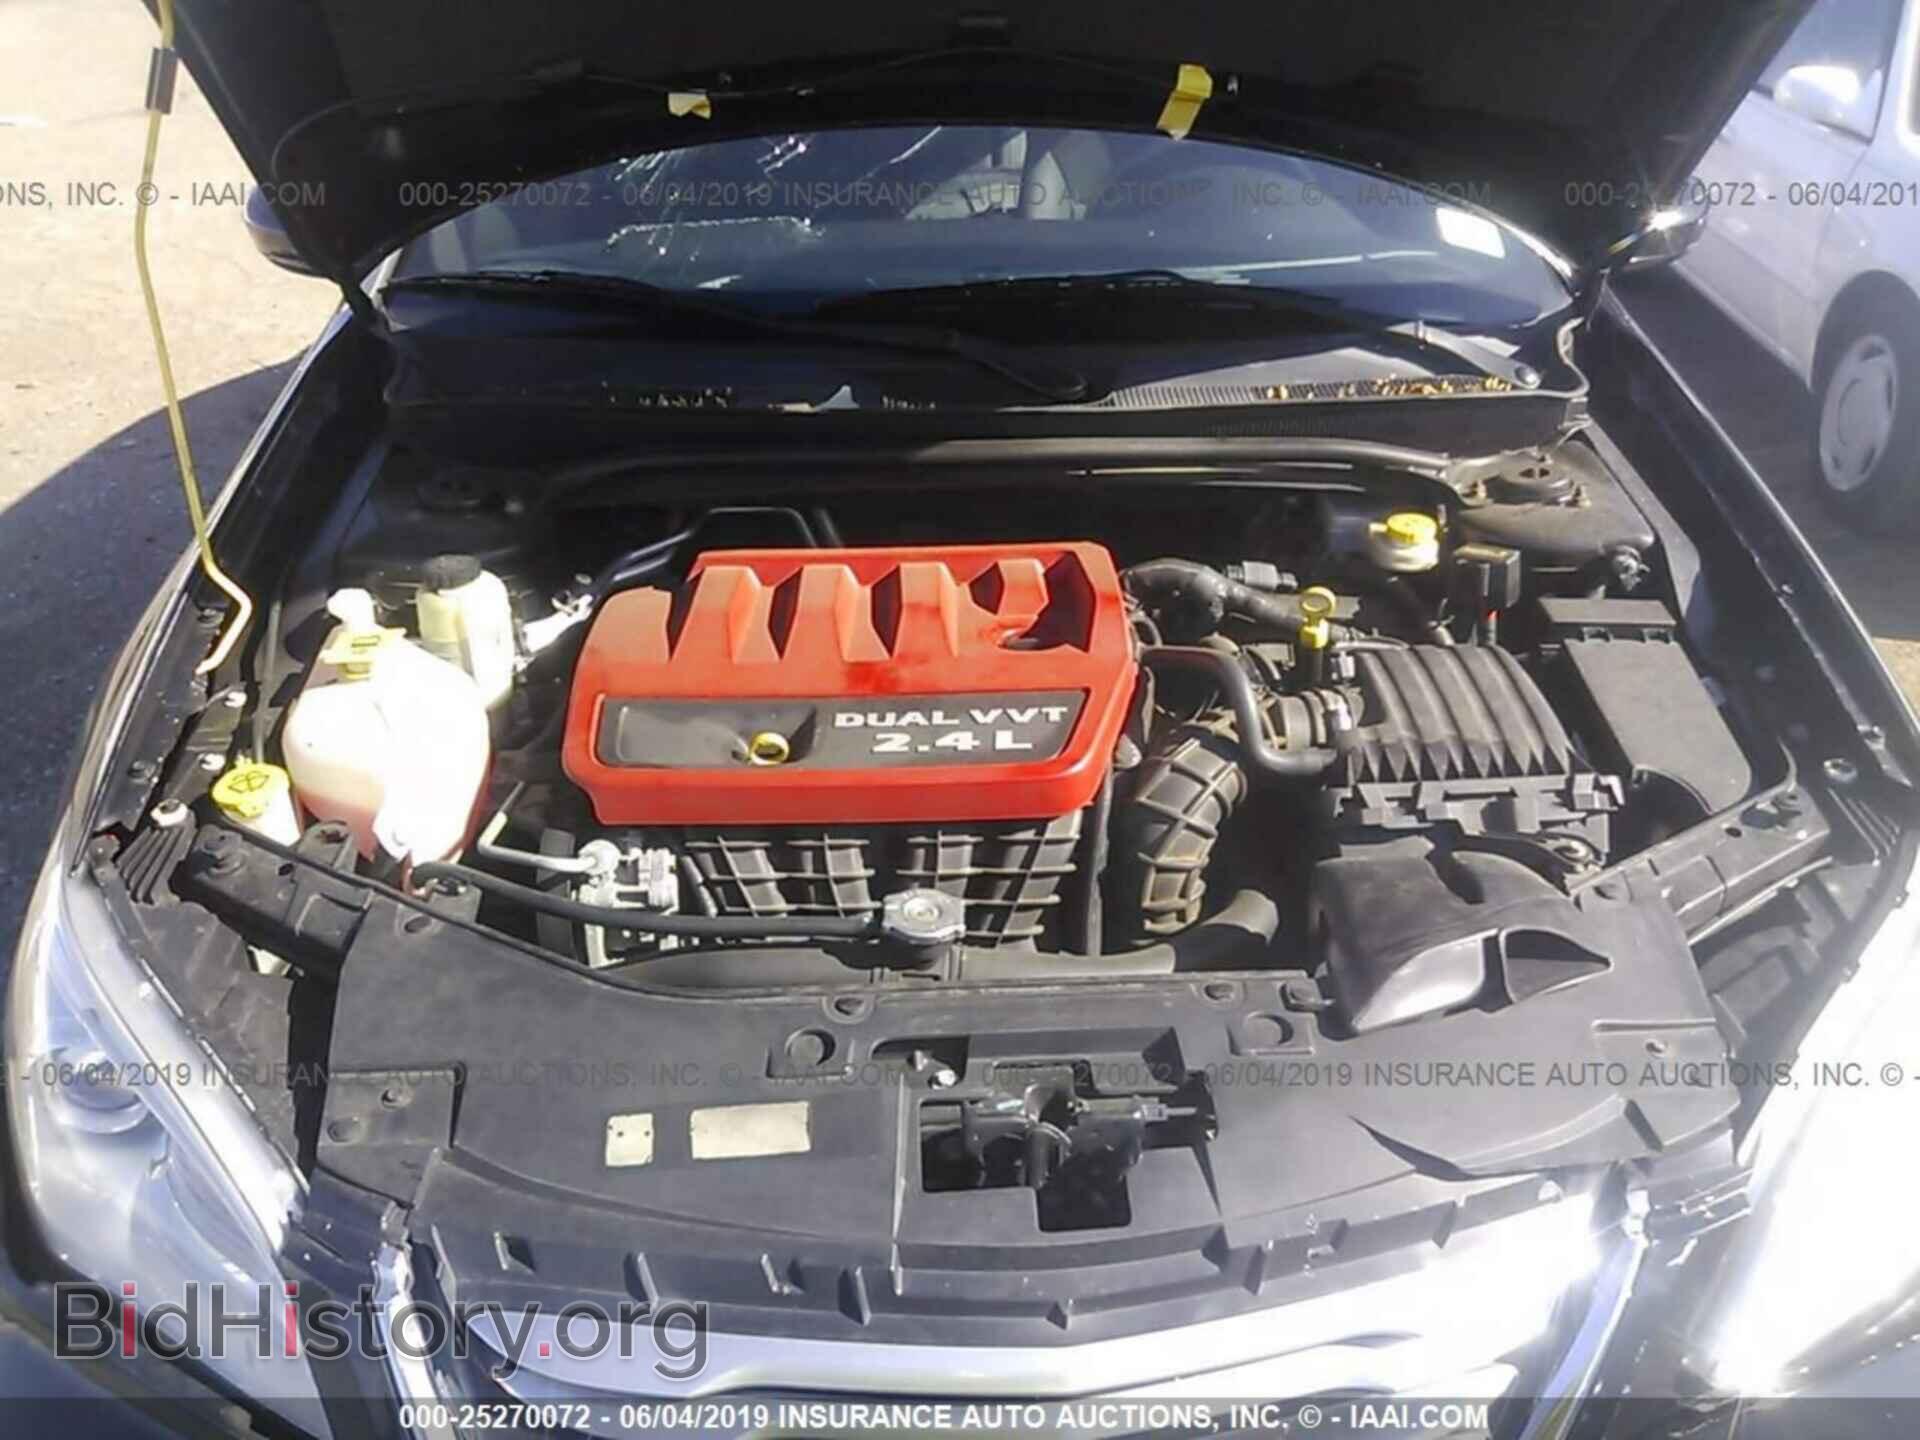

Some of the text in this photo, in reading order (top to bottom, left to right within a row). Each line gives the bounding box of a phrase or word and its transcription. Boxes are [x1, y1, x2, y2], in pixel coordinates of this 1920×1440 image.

[834, 707, 1068, 728] DUAL VVT
[872, 730, 1033, 753] 2.4 L
